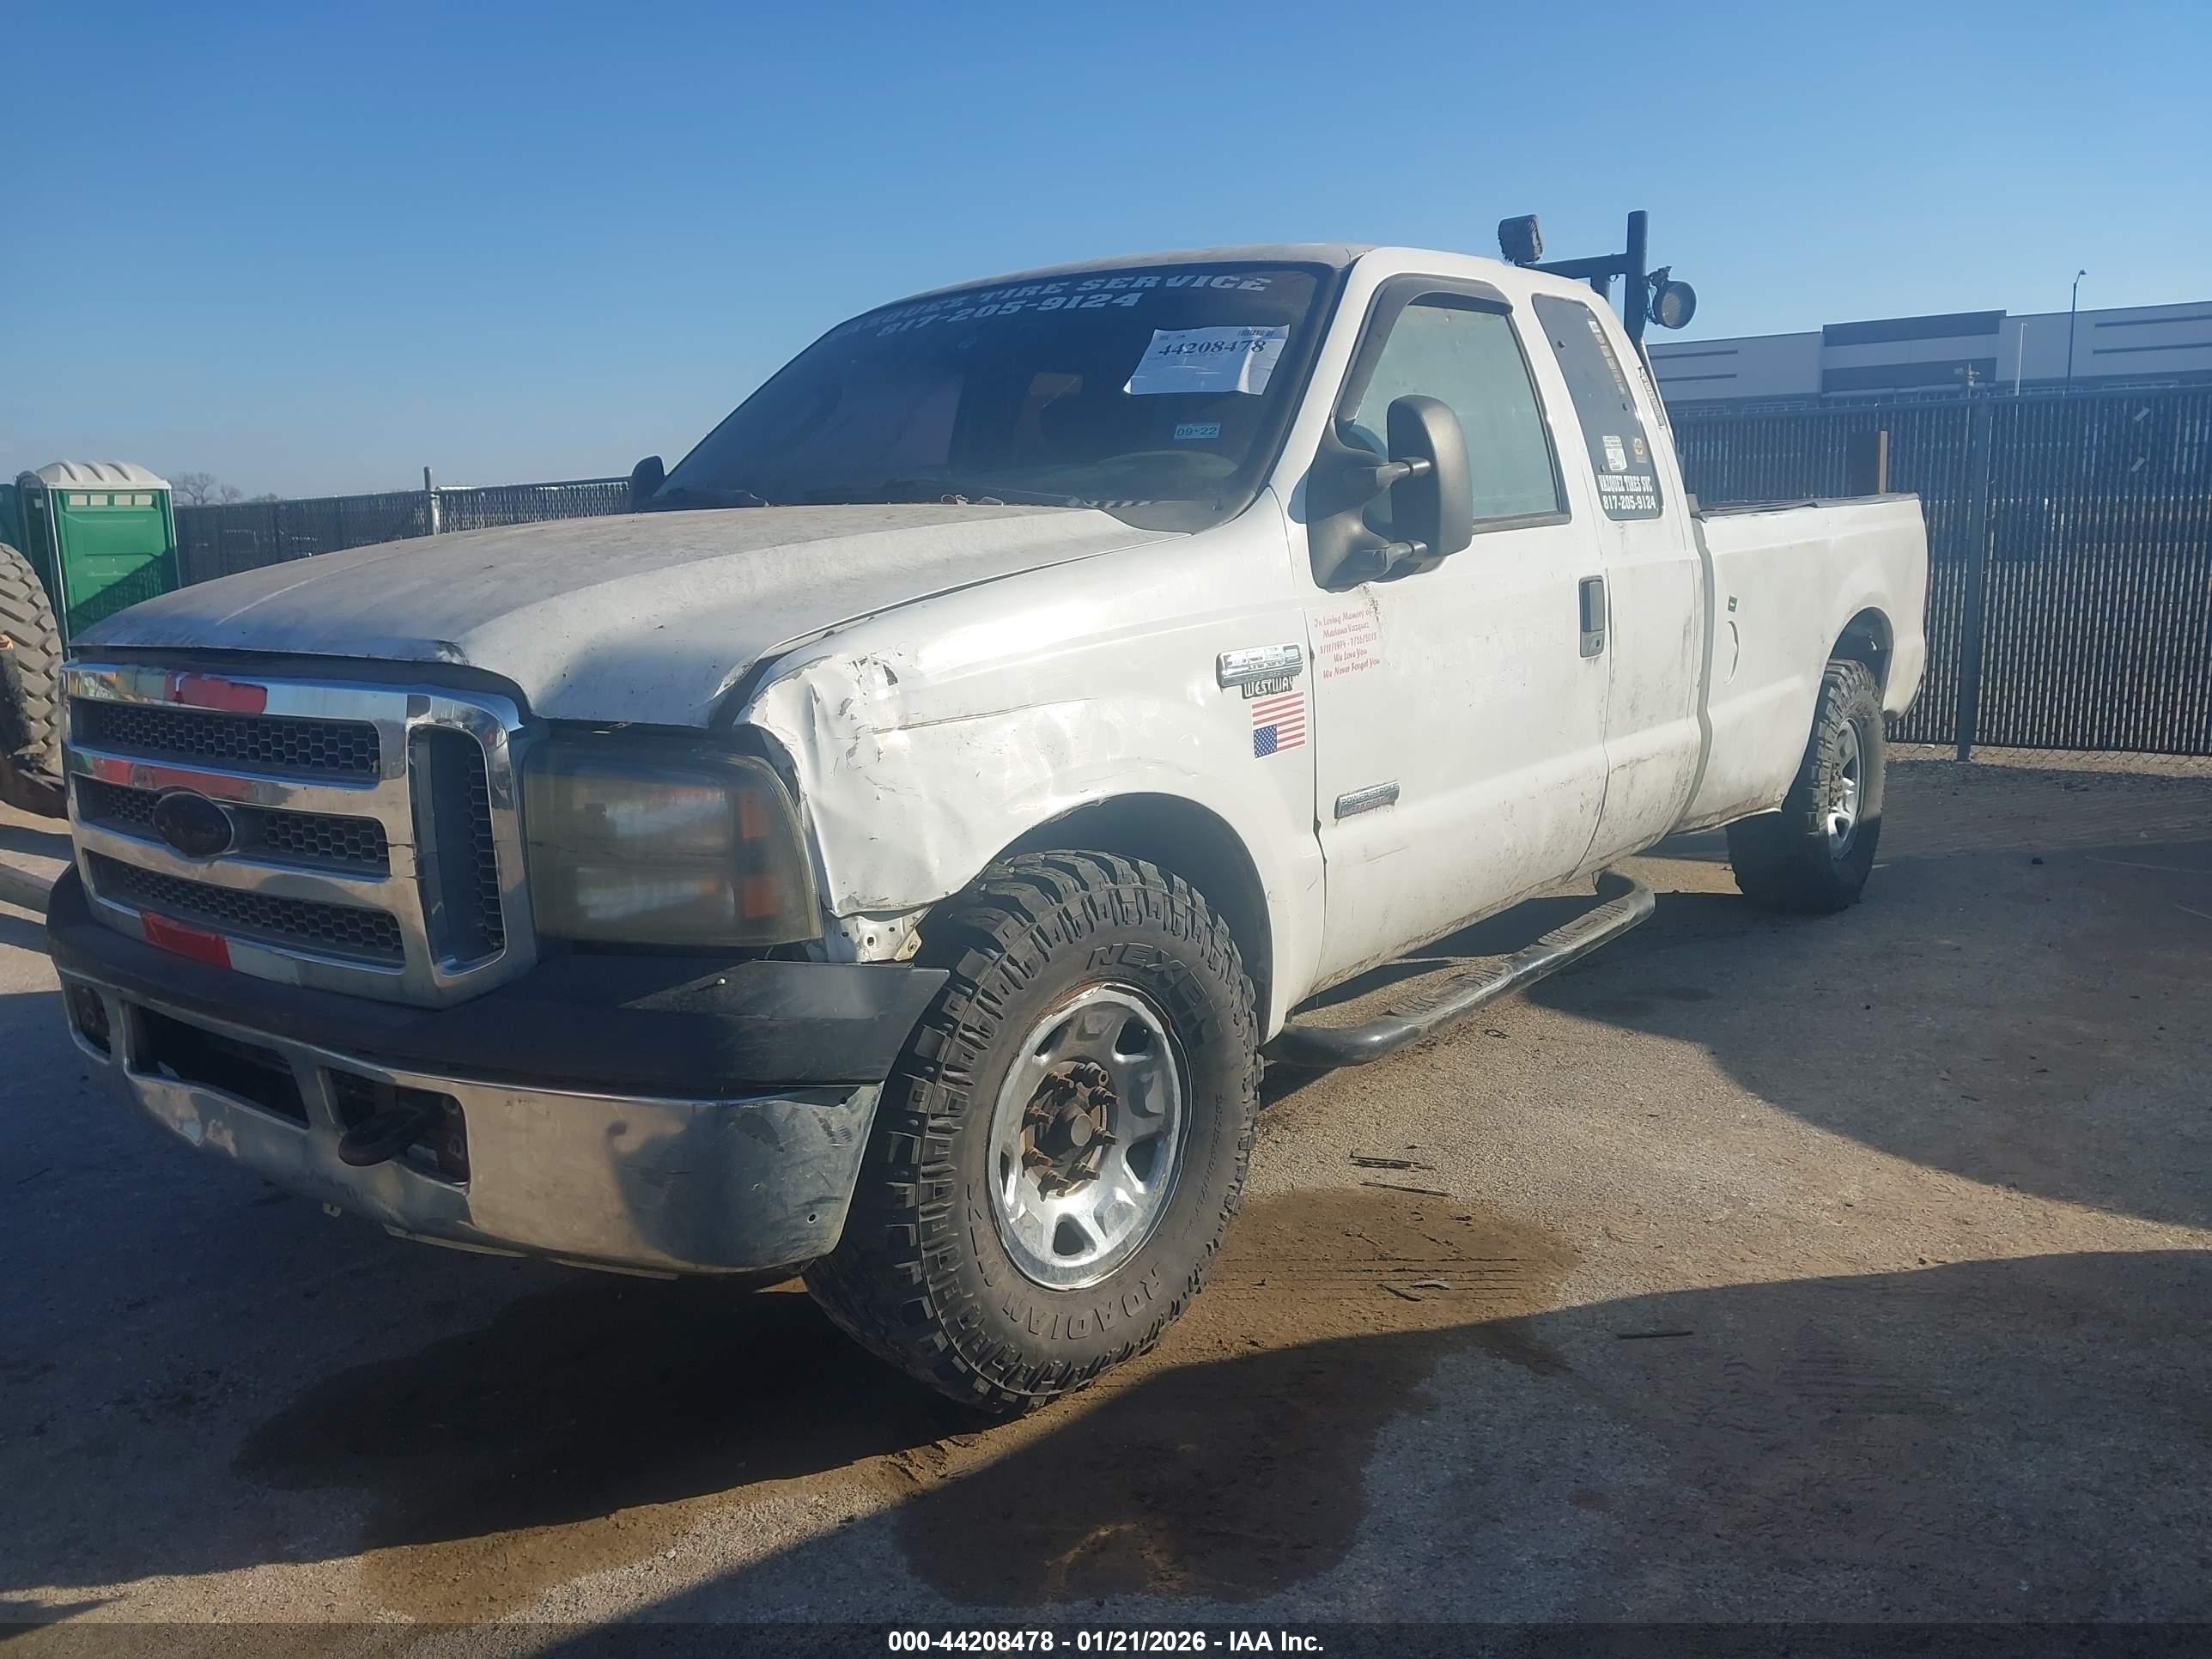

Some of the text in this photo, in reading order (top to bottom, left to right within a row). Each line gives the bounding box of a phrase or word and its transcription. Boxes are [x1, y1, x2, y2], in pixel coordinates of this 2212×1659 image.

[979, 282, 1071, 303] TIRE
[1076, 275, 1272, 291] SERVICE
[876, 292, 1144, 337] 817-205-9124
[1158, 339, 1266, 356] 44208478
[1602, 495, 1656, 509] 817-205-9124
[1323, 615, 1341, 627] Loving
[1342, 611, 1364, 622] Memory
[1334, 648, 1368, 663] We Love You
[1323, 657, 1380, 679] We Never Forget You
